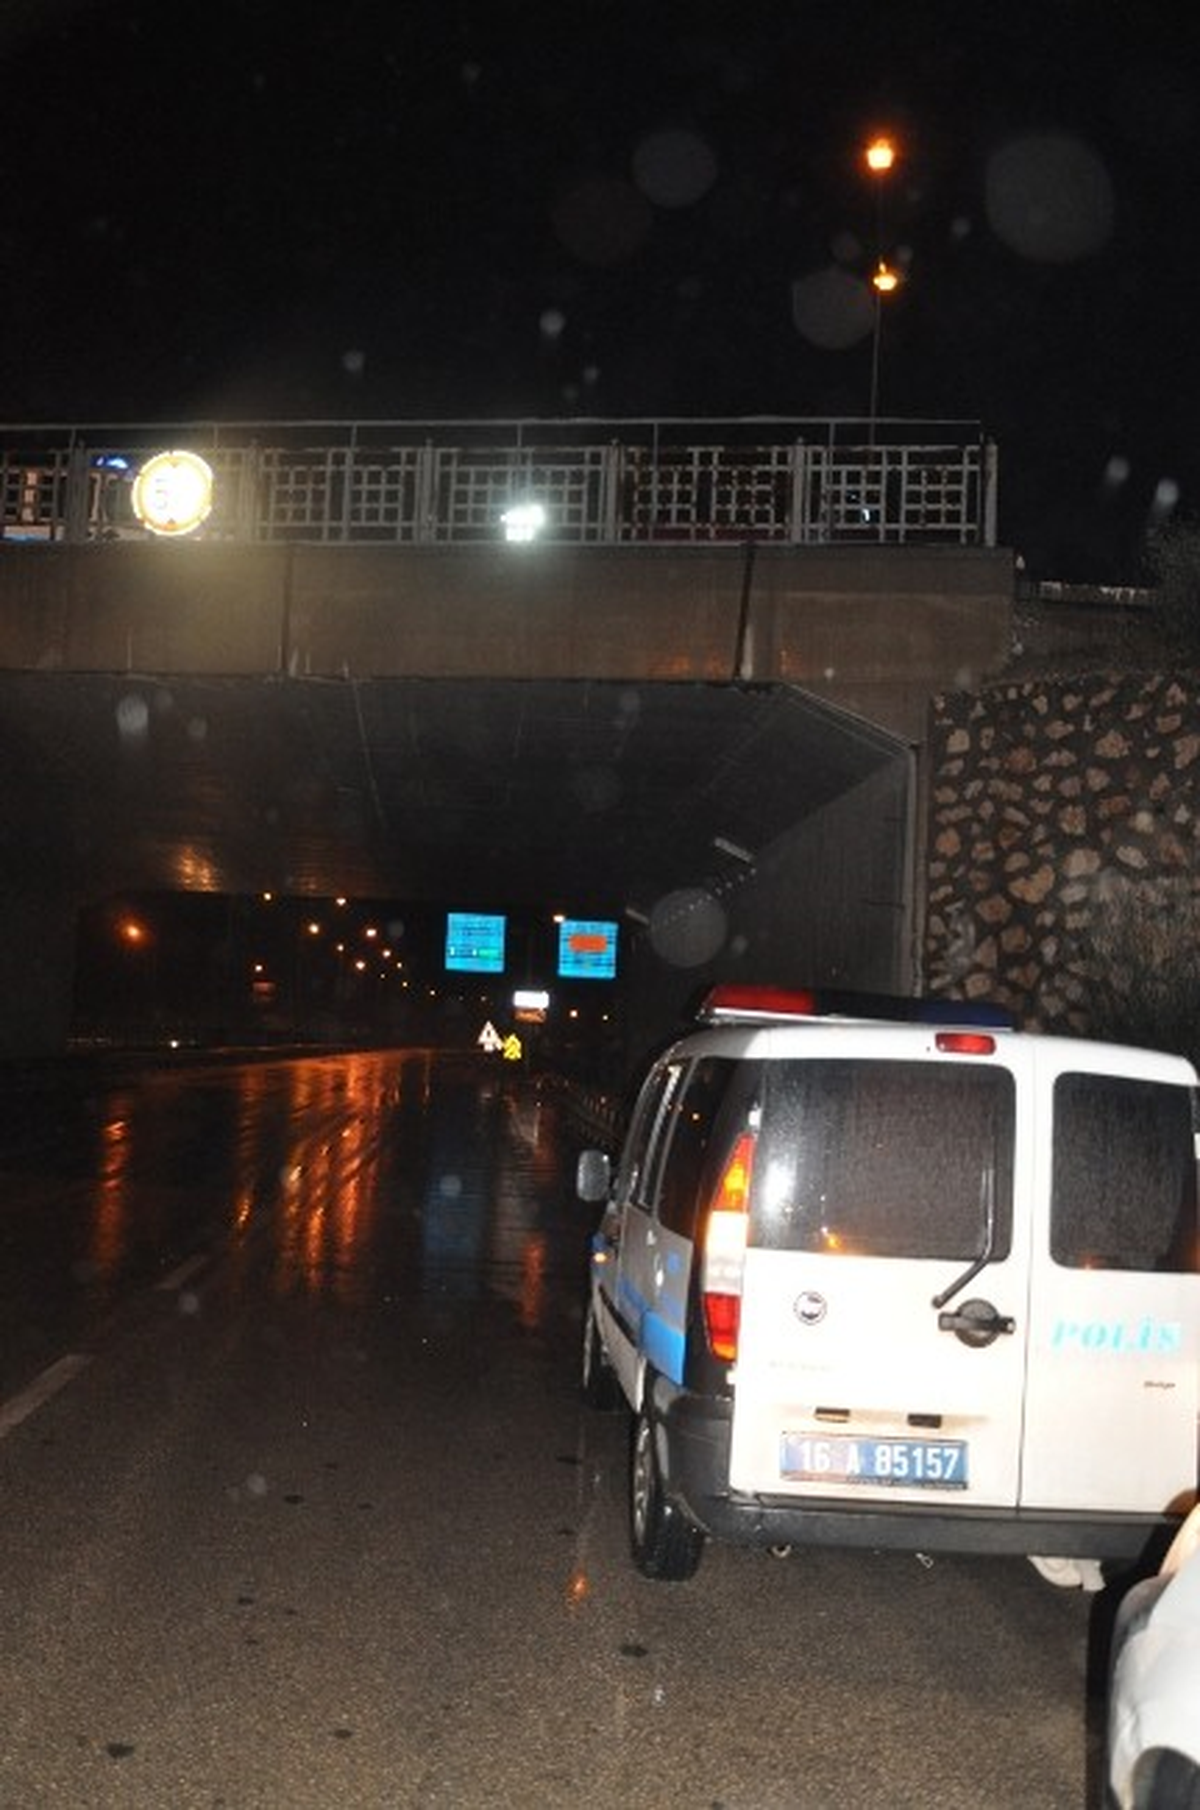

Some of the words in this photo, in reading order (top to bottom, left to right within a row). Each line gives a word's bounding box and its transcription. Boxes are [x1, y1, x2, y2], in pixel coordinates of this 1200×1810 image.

[801, 1440, 830, 1472] 16
[845, 1443, 861, 1475] A
[874, 1444, 960, 1479] 85157
